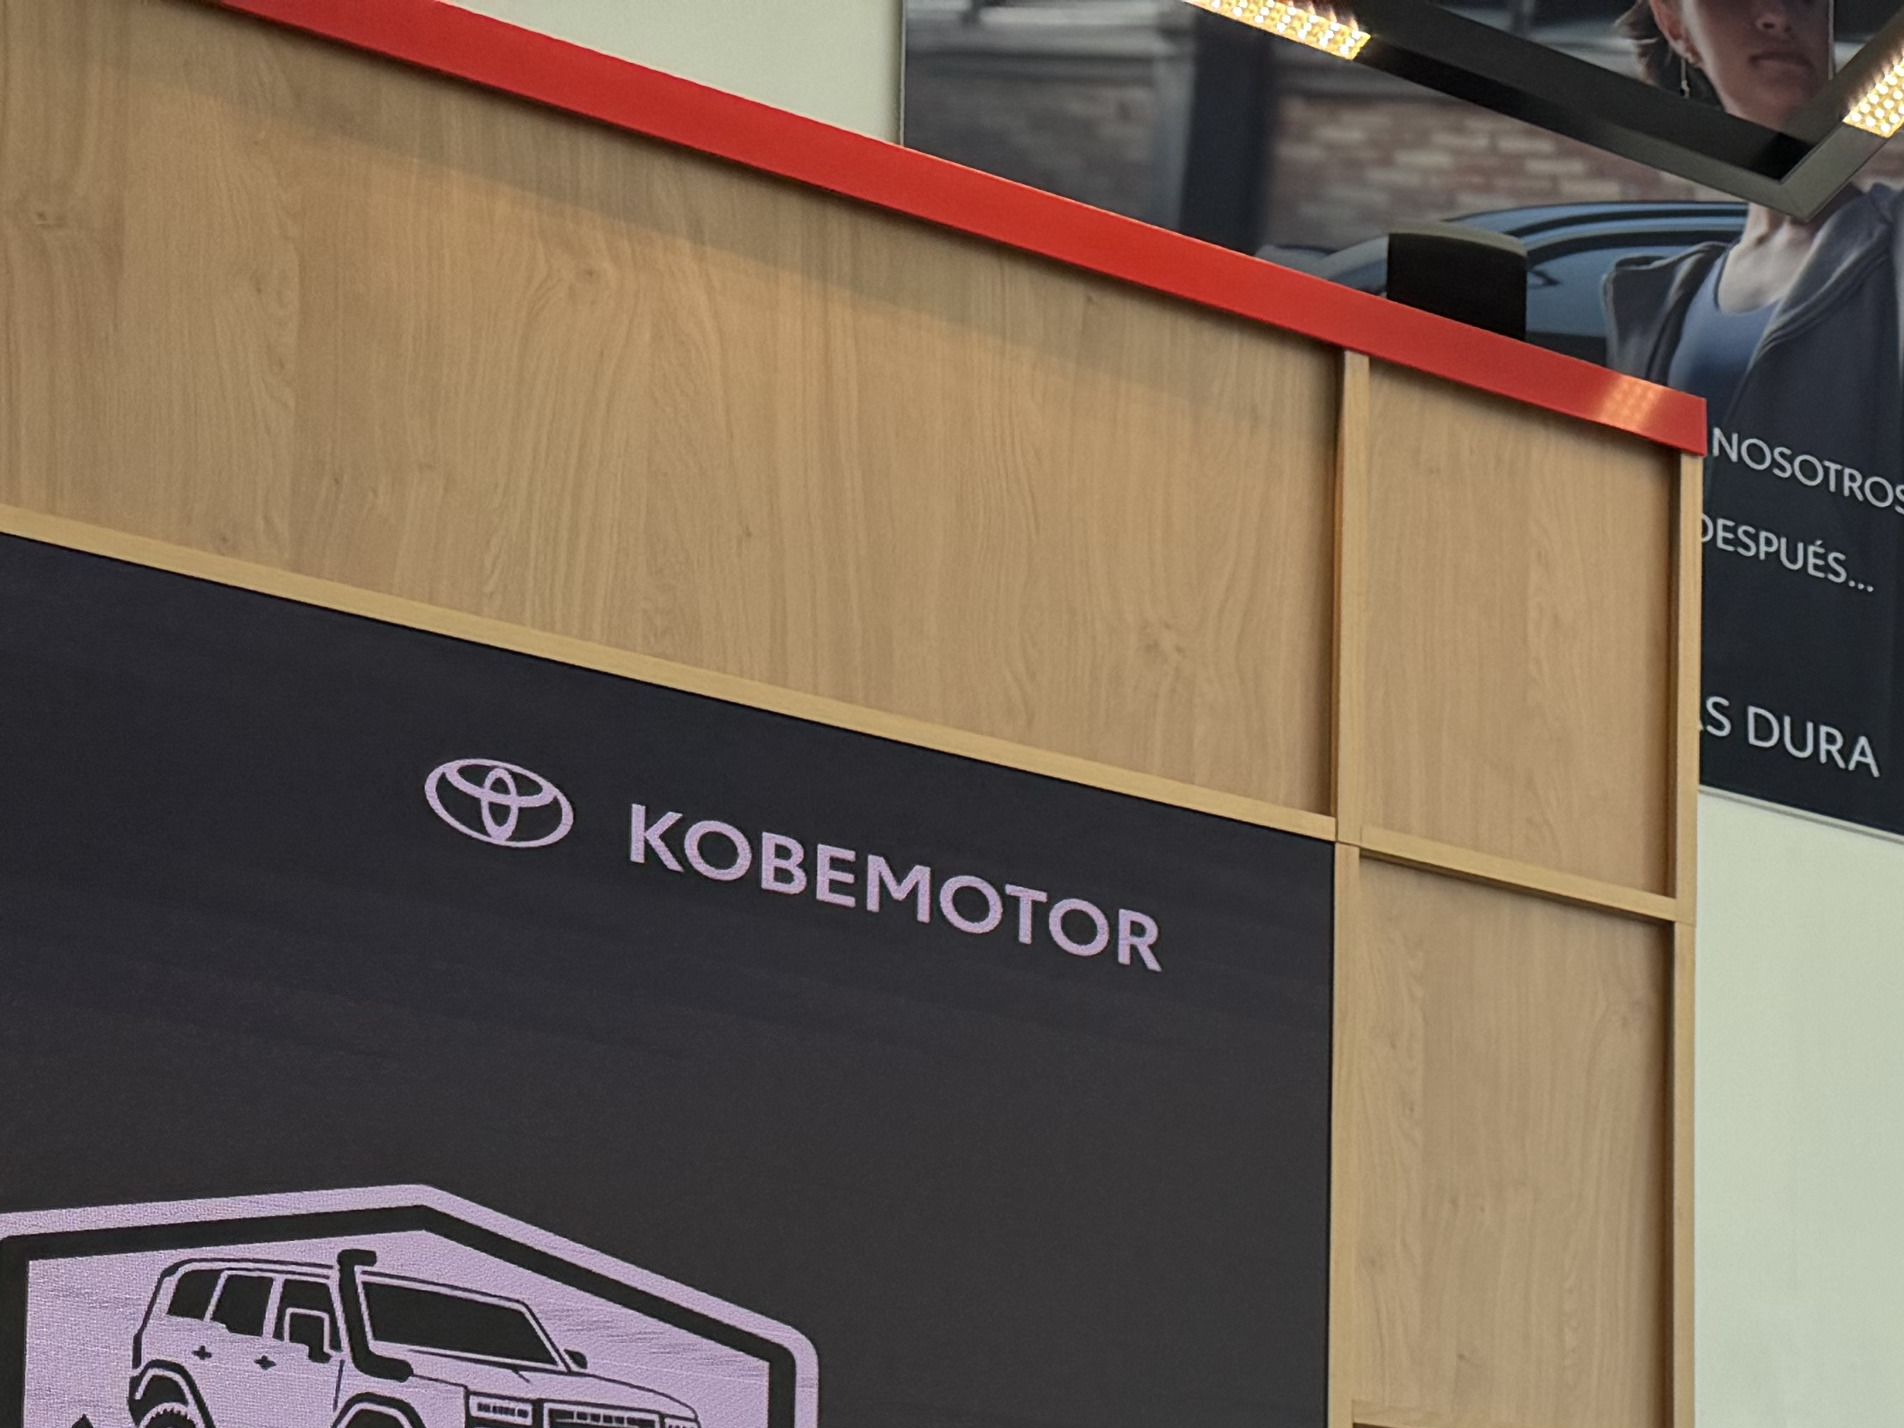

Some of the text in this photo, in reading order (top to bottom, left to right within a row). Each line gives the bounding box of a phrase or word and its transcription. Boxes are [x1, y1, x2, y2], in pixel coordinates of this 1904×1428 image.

[1699, 695, 1880, 778] S DURA
[629, 802, 1163, 973] KOBEMOTOR
